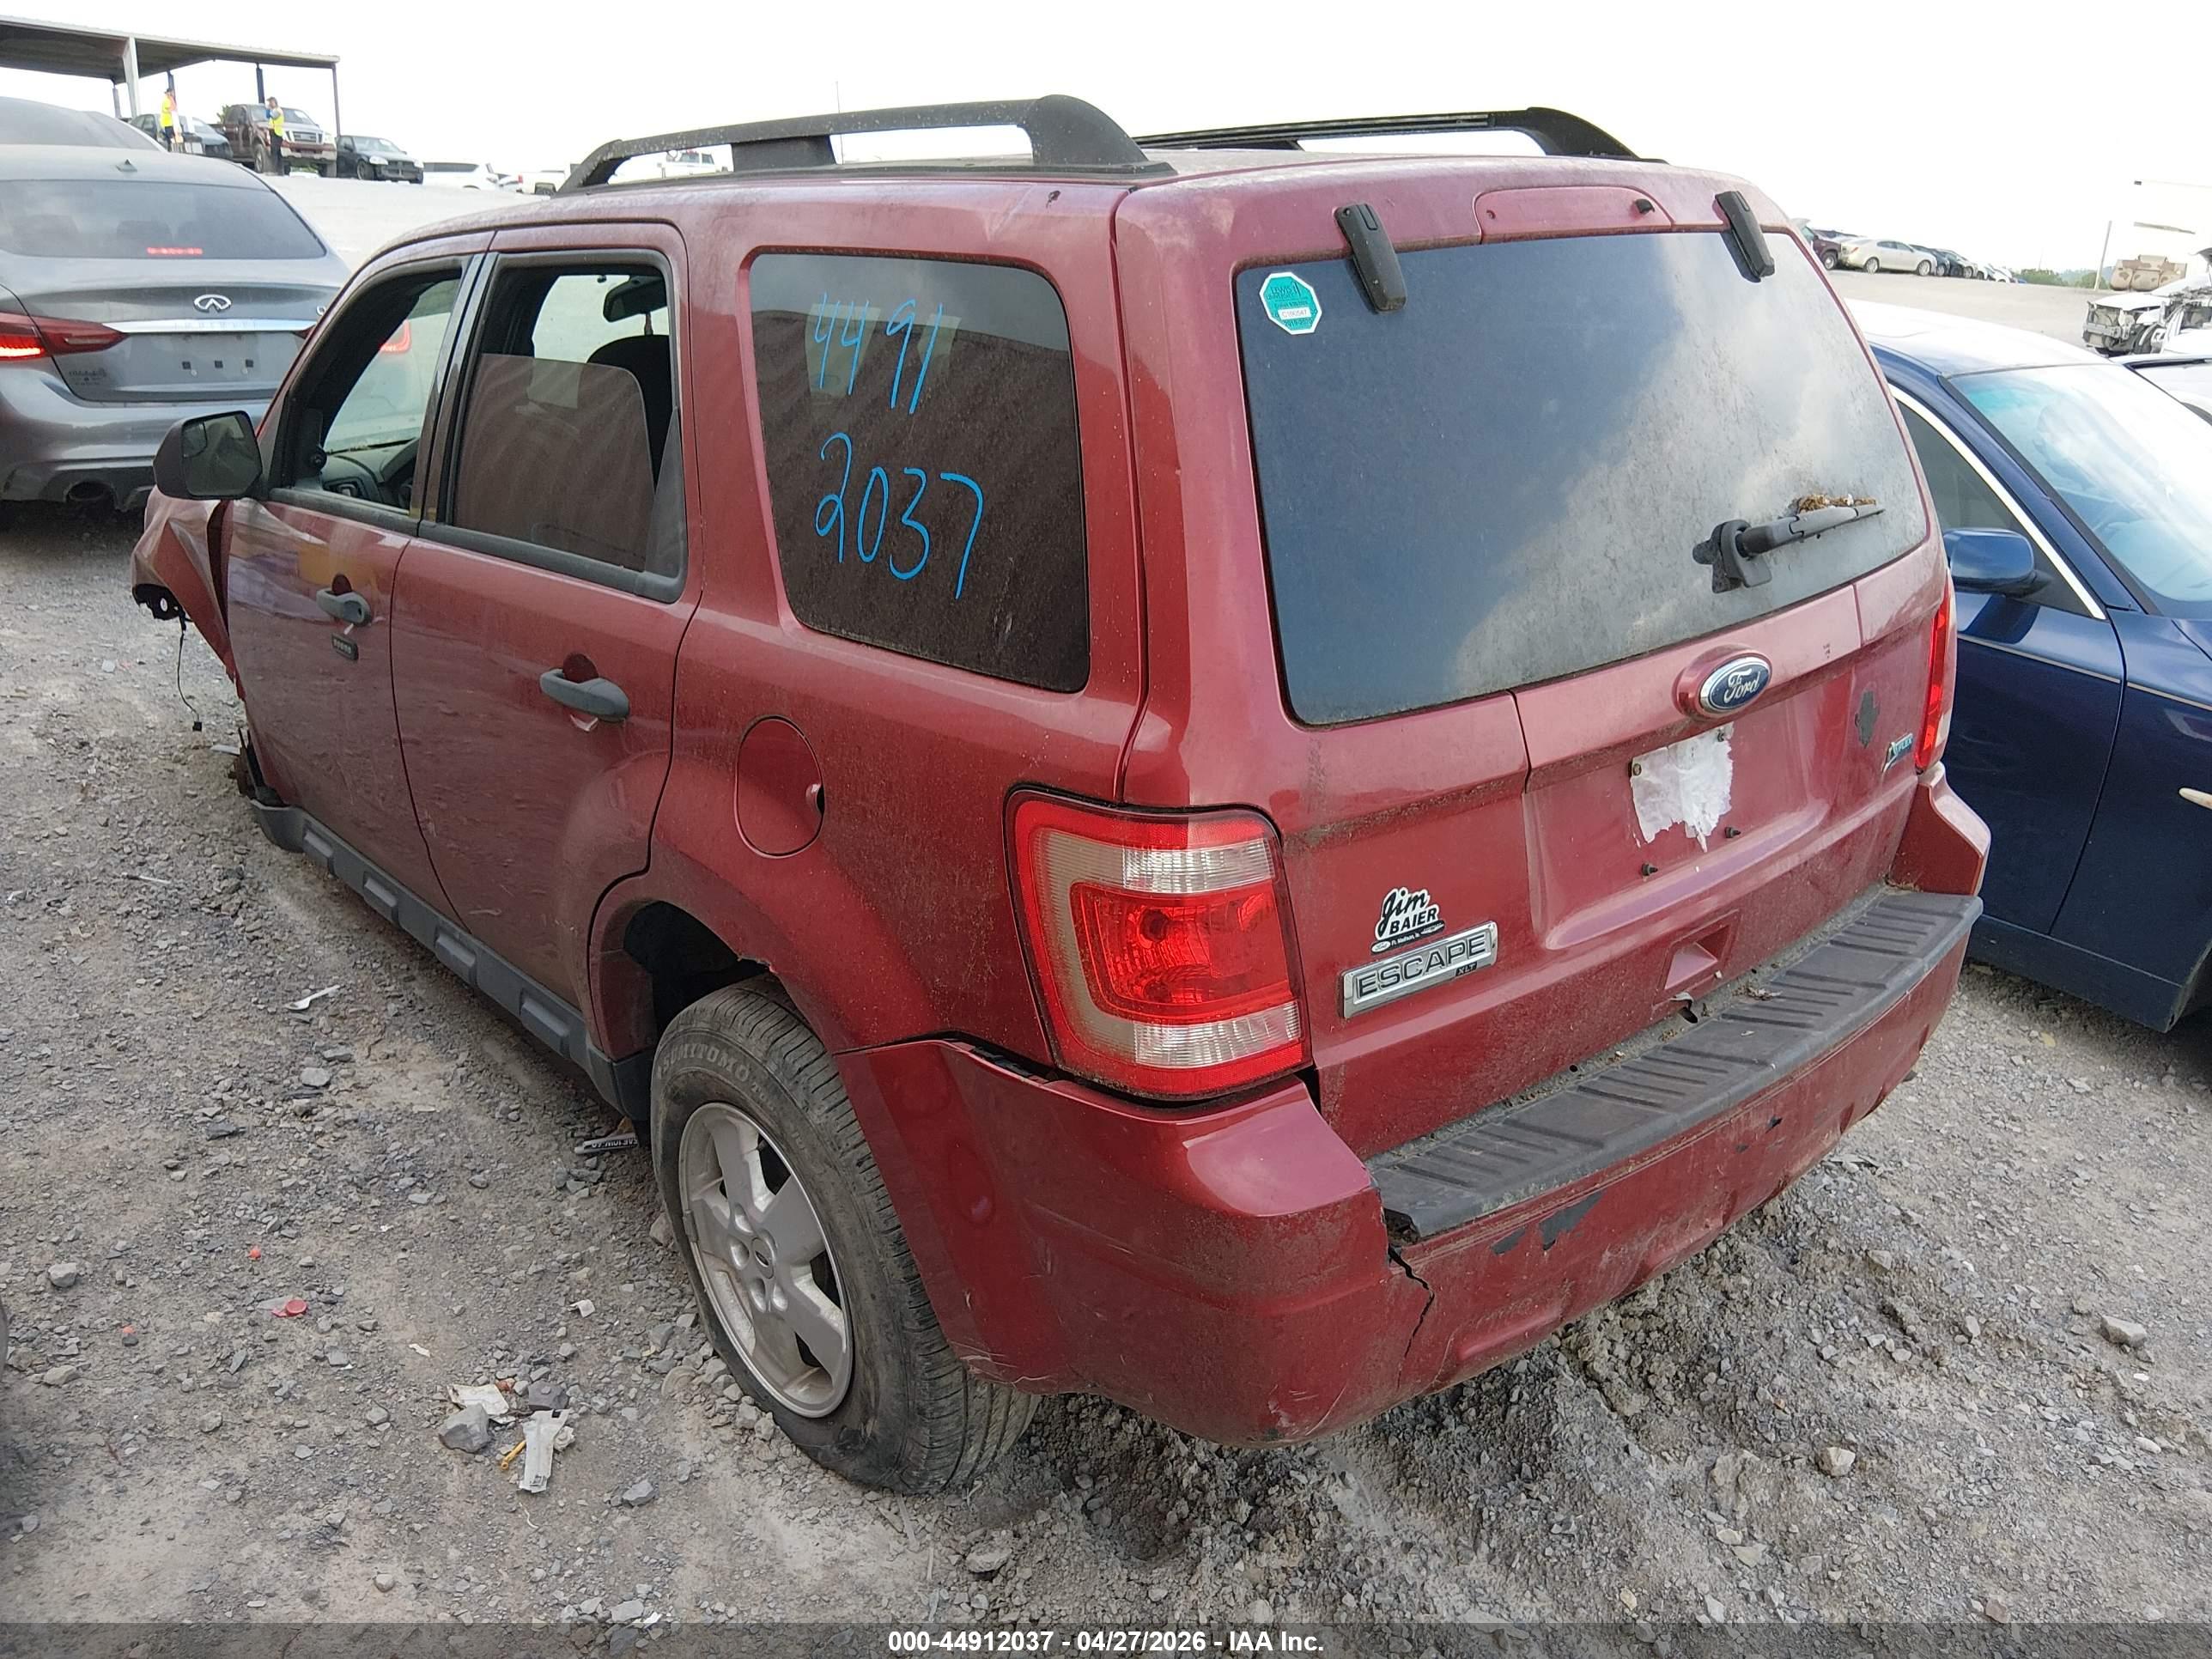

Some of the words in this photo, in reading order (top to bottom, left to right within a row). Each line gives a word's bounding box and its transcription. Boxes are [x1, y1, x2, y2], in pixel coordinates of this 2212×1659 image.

[815, 291, 943, 414] 4491
[816, 432, 983, 600] 2037
[1723, 668, 1761, 703] Ford
[1377, 890, 1427, 938] Jim
[1389, 907, 1437, 935] BAIER
[1357, 933, 1487, 998] ESCAPE
[1458, 963, 1476, 975] XLT
